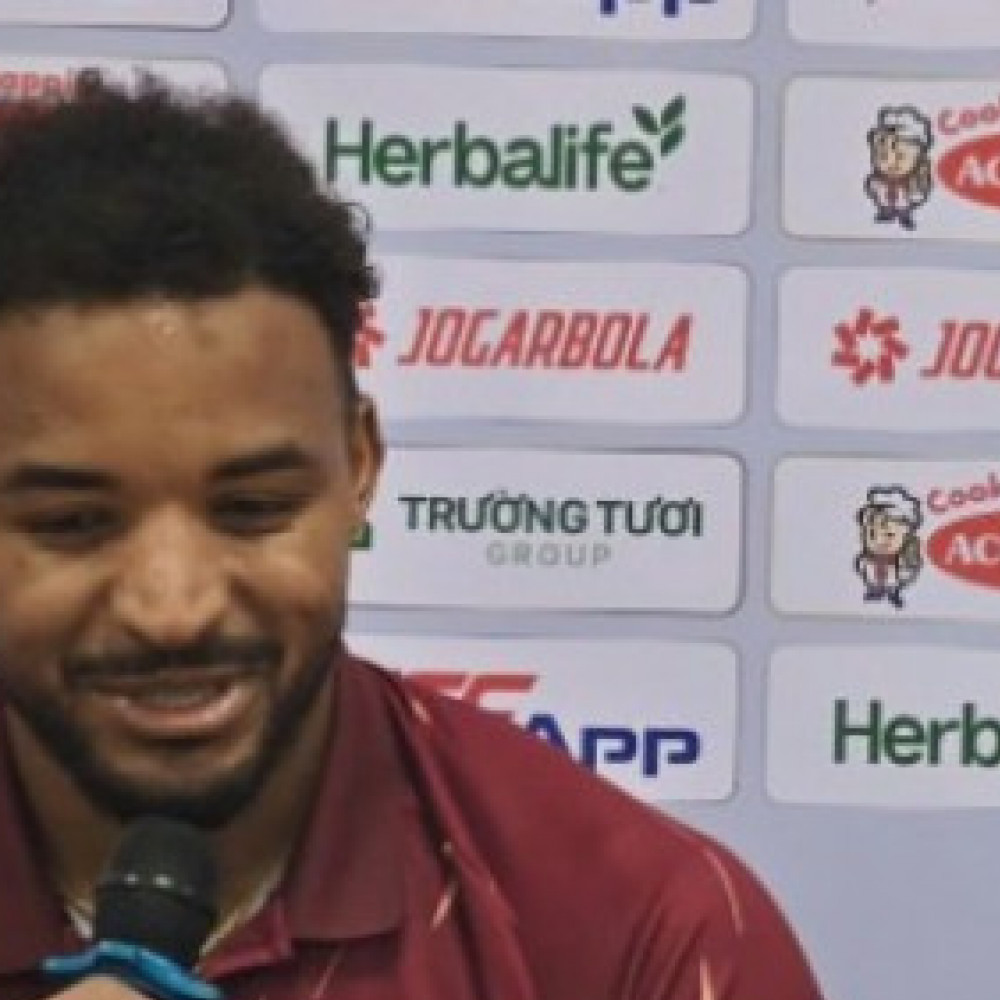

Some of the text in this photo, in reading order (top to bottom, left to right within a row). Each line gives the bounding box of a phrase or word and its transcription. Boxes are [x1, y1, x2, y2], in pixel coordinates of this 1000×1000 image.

[326, 118, 653, 191] Herbalife
[398, 308, 694, 371] JOGARBOLA
[398, 489, 588, 534] TRƯỜNG
[486, 541, 612, 567] GROUP
